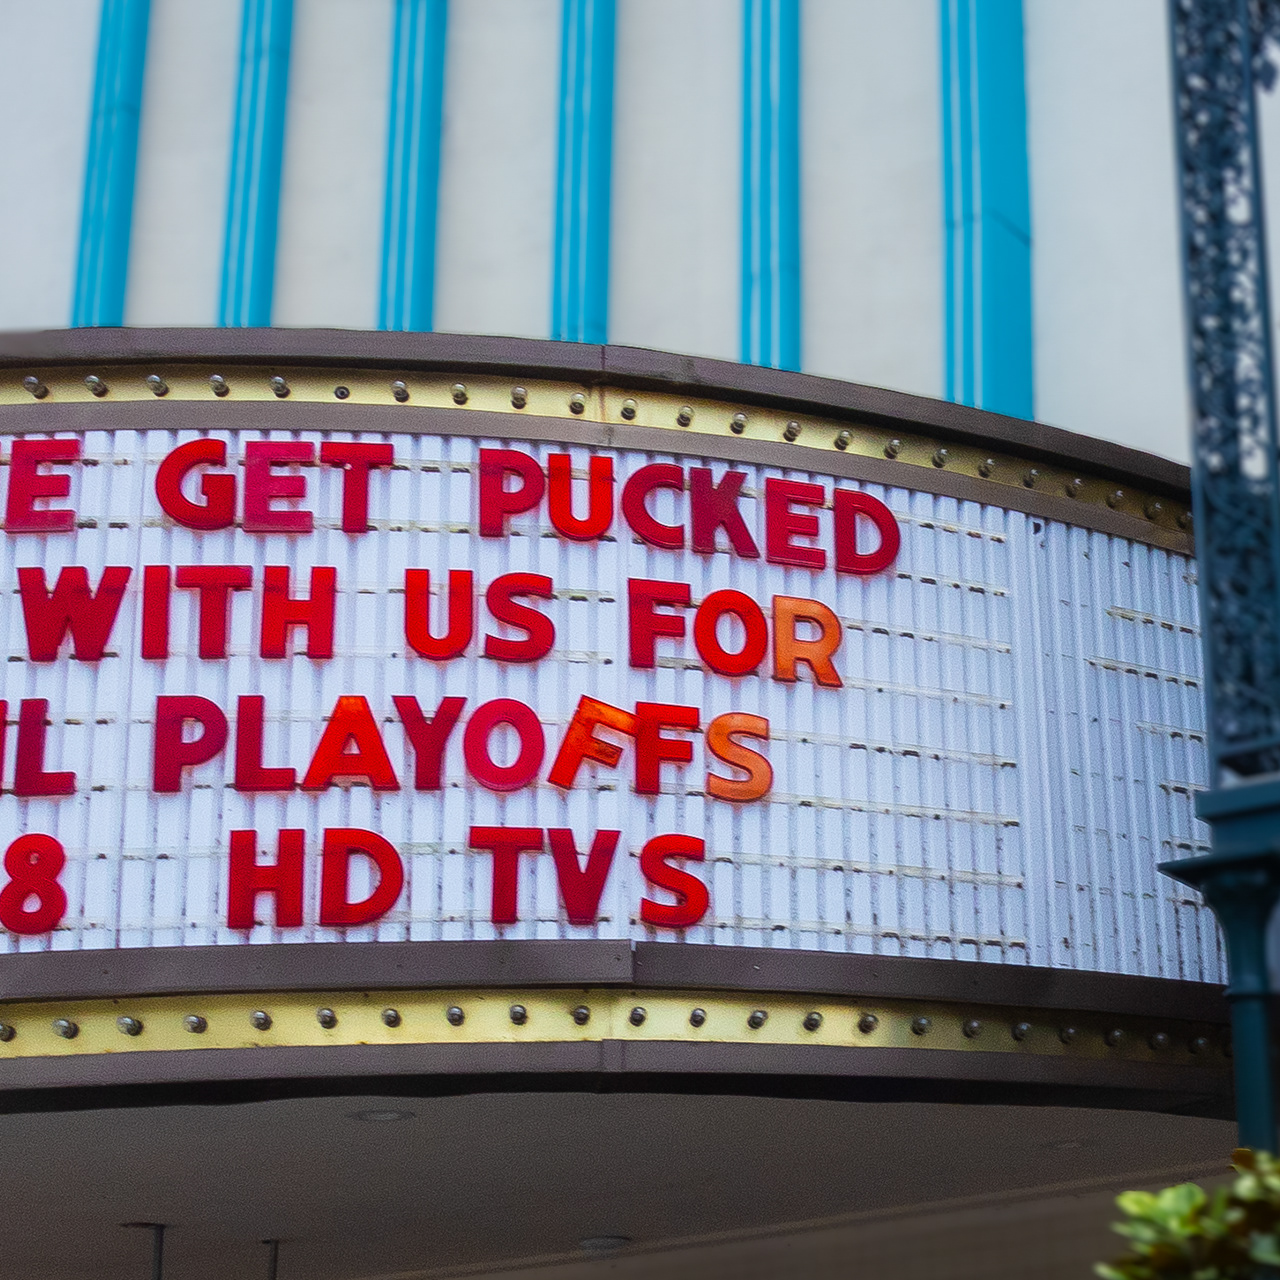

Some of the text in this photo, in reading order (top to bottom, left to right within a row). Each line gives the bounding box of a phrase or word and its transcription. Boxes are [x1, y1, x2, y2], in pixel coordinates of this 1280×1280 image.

[156, 438, 394, 535] GET
[477, 449, 900, 576] PUCKED
[19, 564, 337, 663] WITH
[404, 569, 555, 664] US
[628, 579, 842, 688] FOR
[154, 695, 773, 803] PLAYOFFS
[228, 828, 404, 930] HD
[470, 827, 710, 930] TVS
